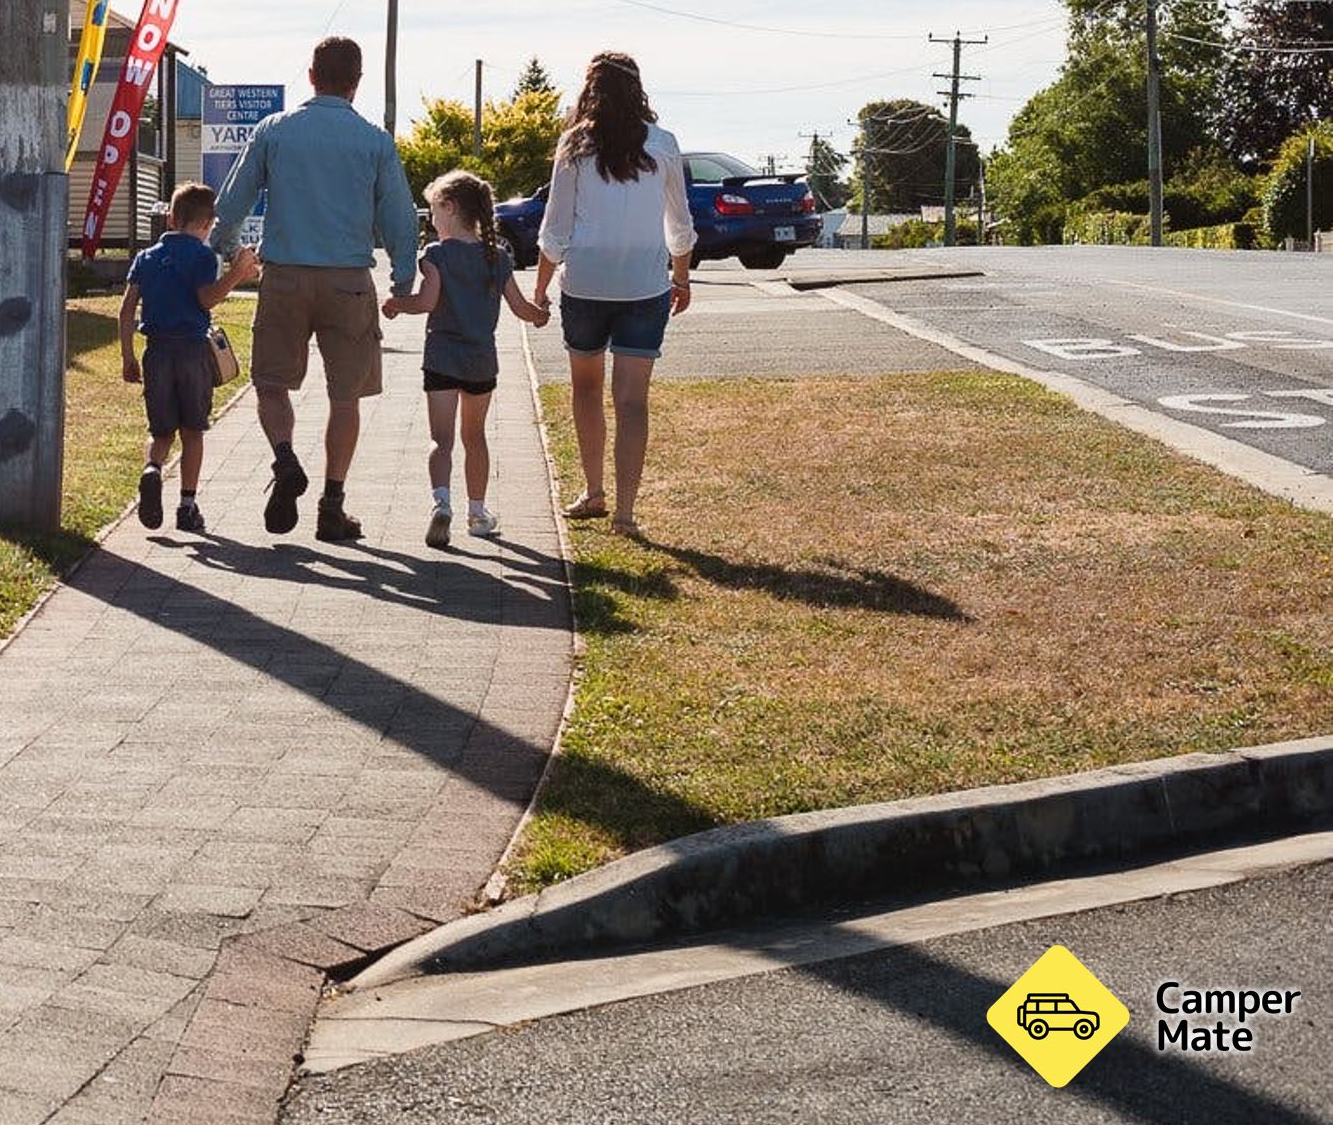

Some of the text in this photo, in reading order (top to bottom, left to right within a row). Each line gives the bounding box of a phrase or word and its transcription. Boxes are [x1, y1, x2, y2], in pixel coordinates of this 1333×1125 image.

[209, 88, 279, 98] GREAT WESTERN
[214, 99, 272, 109] TIERS VISITOR
[227, 110, 259, 121] CENTRE
[1020, 330, 1333, 361] BUS
